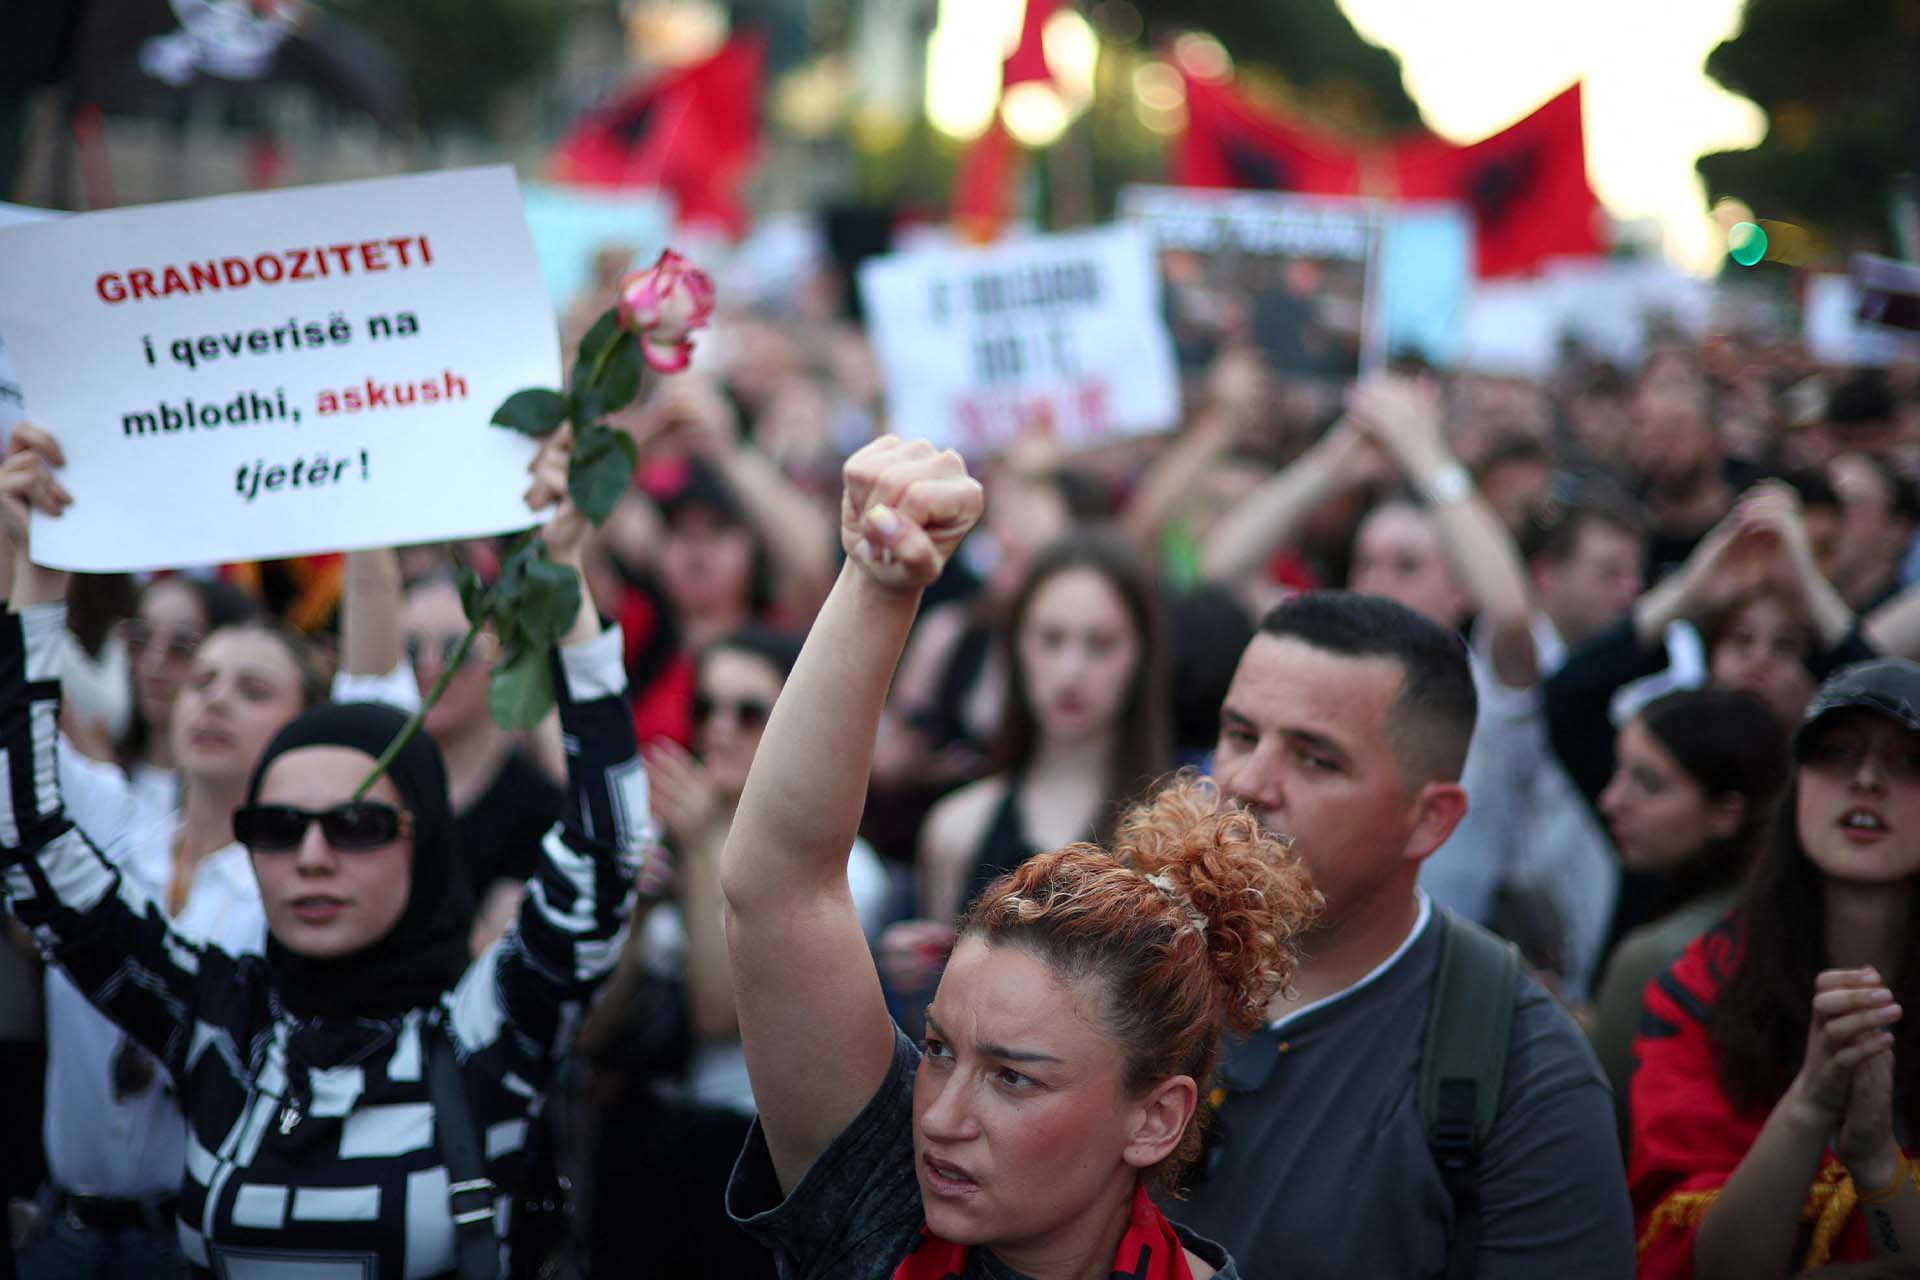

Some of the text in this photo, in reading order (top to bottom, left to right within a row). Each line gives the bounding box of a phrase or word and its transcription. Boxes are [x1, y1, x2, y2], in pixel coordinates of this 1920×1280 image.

[96, 234, 434, 305] GRANDOZITETI
[142, 311, 420, 370] i qeverisë na
[121, 370, 468, 437] mblodhi, askush
